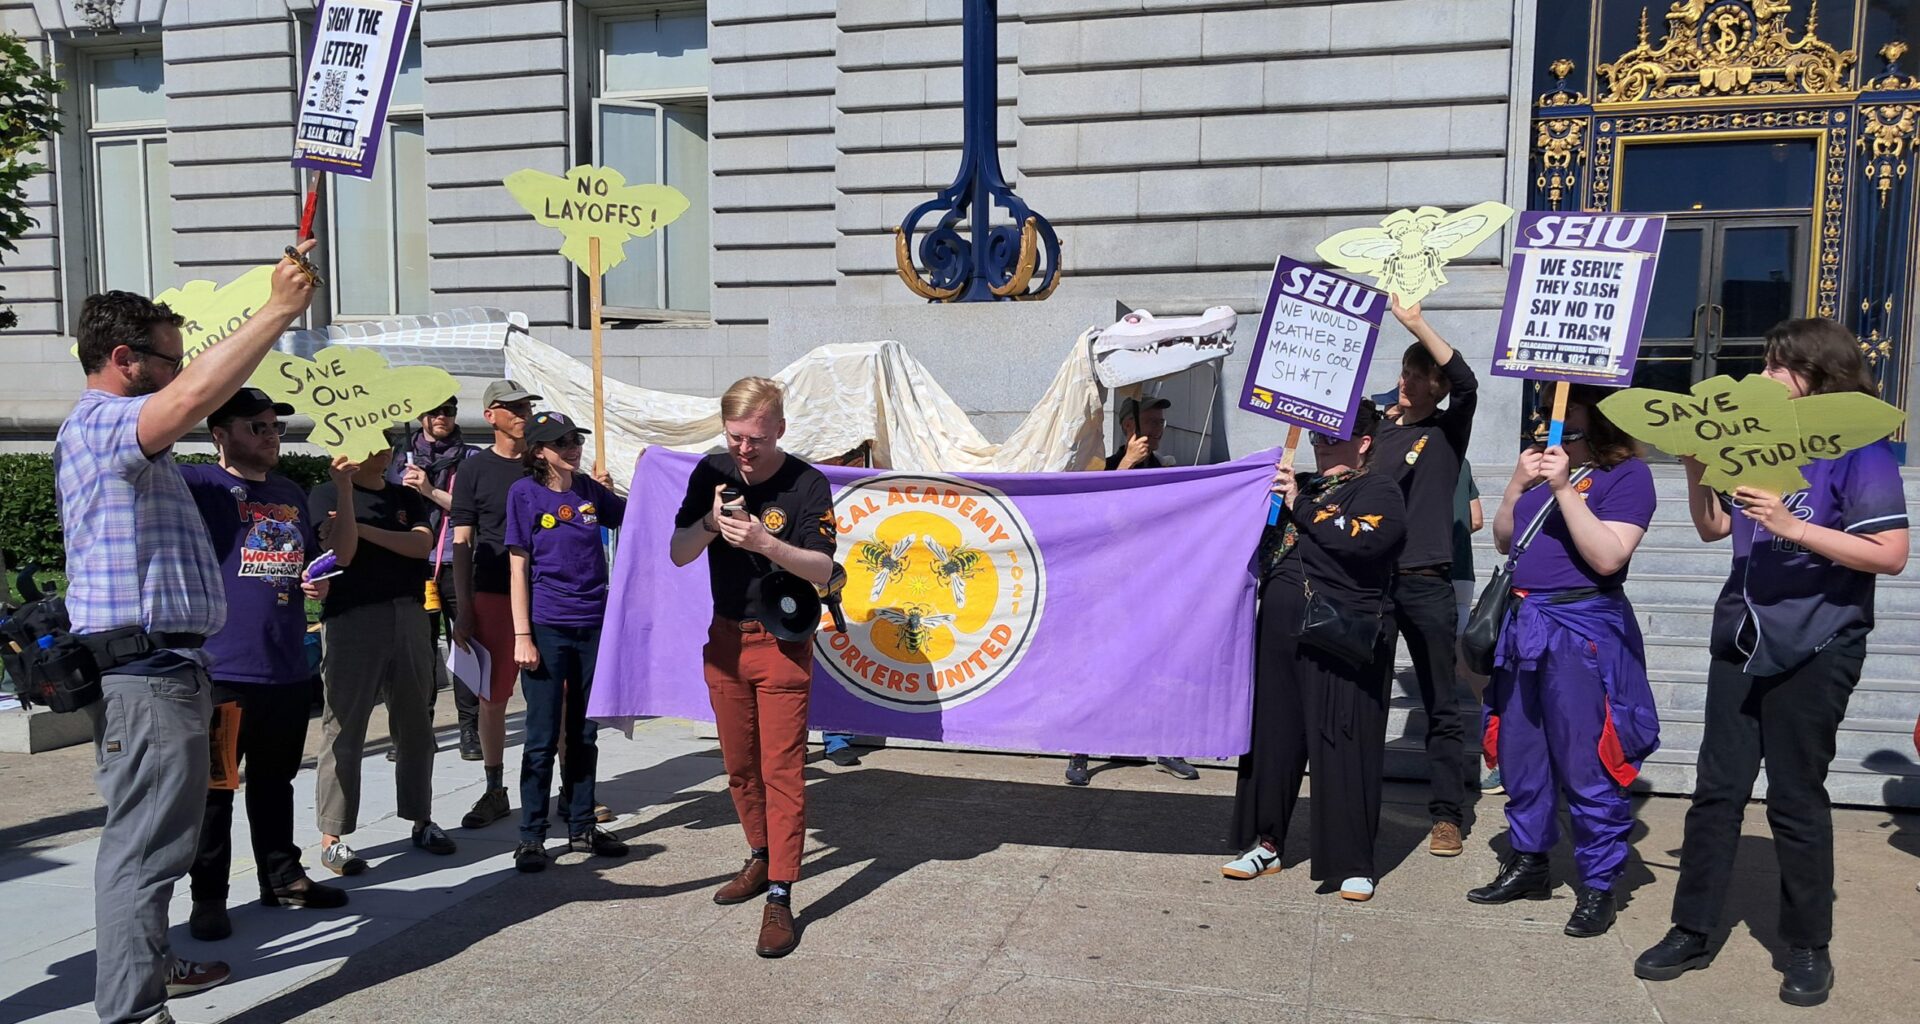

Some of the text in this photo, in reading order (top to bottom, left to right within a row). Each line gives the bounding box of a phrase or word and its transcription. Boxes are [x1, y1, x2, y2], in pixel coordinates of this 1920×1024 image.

[327, 7, 383, 36] SIGN THE
[321, 41, 368, 69] LETTER!
[326, 129, 343, 143] 1021
[577, 176, 609, 197] NO
[1529, 216, 1648, 249] SEIU
[1540, 258, 1624, 280] WE SERVE
[1282, 266, 1378, 315] SEIU
[1536, 279, 1619, 299] THEY SLASH
[1280, 300, 1358, 332] WE WOULD
[1530, 299, 1615, 321] SAY NO TO
[1275, 321, 1362, 354] RATHER BE
[1524, 320, 1611, 343] A.I. TRASH
[1269, 339, 1355, 371] MAKING COOL
[1568, 354, 1590, 365] 1021
[280, 359, 346, 395] SAVE
[312, 384, 369, 407] OUR
[1249, 398, 1271, 410] SEIU
[1644, 391, 1740, 427] SAVE
[325, 398, 413, 447] STUDIOS
[1276, 401, 1314, 419] LOCAL
[1317, 413, 1343, 428] 1021
[1695, 417, 1771, 441] OUR
[1719, 434, 1842, 477] STUDIOS
[836, 496, 881, 534] CAL
[887, 485, 1010, 545] ACADEMY
[926, 623, 1013, 692] UNITED
